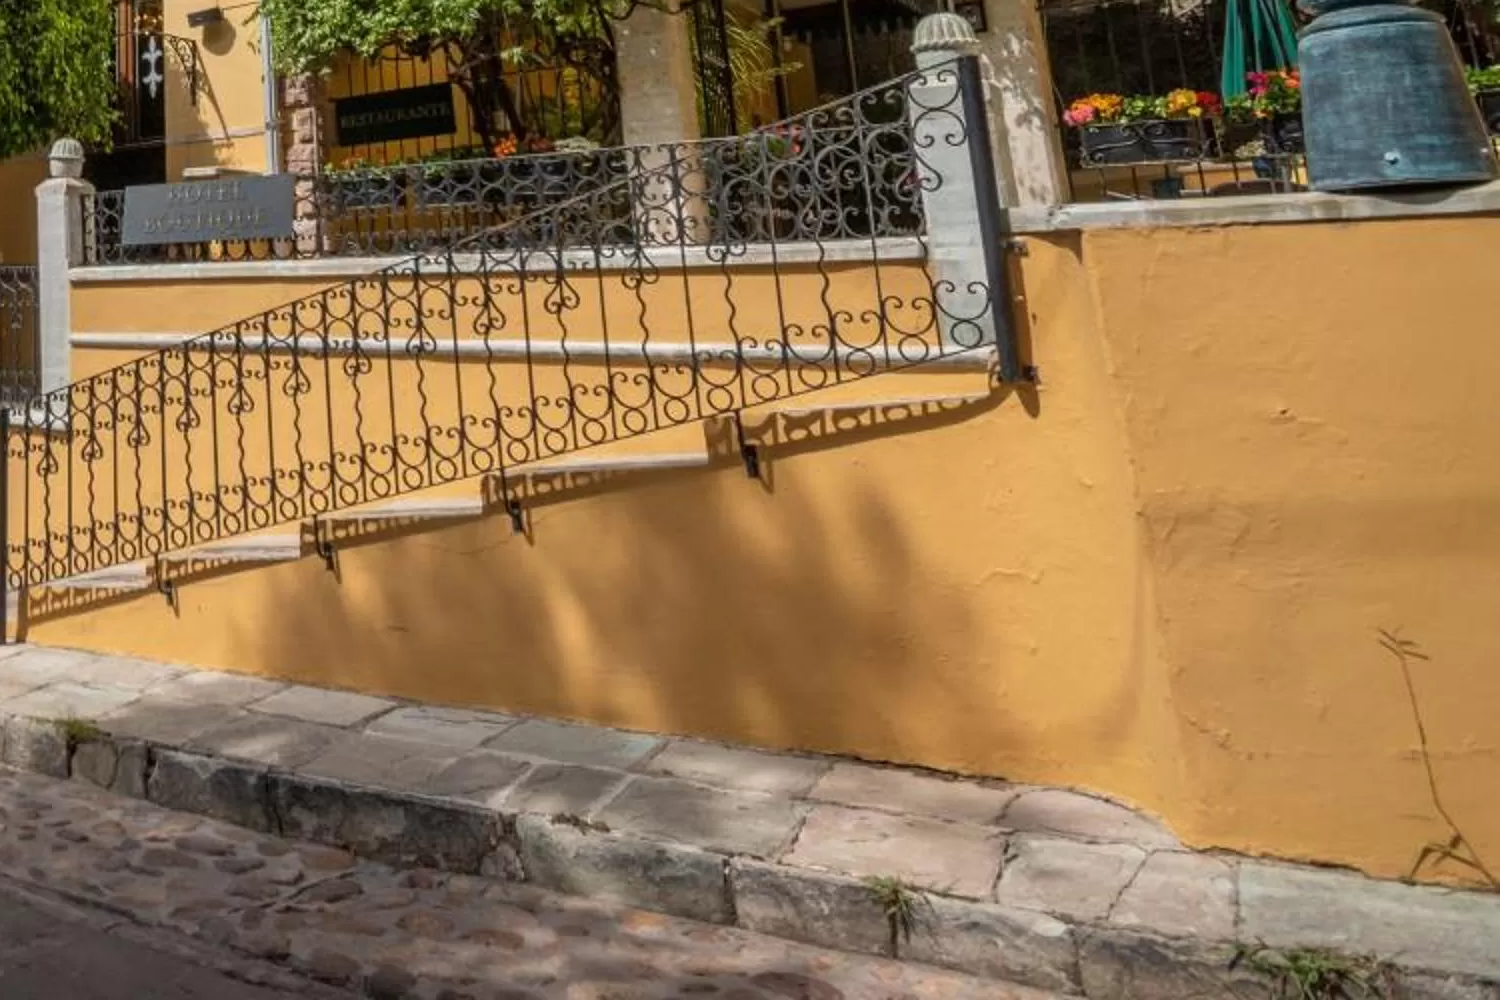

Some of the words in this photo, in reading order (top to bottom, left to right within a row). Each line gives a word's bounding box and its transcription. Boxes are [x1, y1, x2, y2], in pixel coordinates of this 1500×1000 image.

[340, 102, 452, 129] RESTAURANTE
[167, 180, 247, 203] HOTEL
[143, 207, 265, 234] BOUTIQUE
